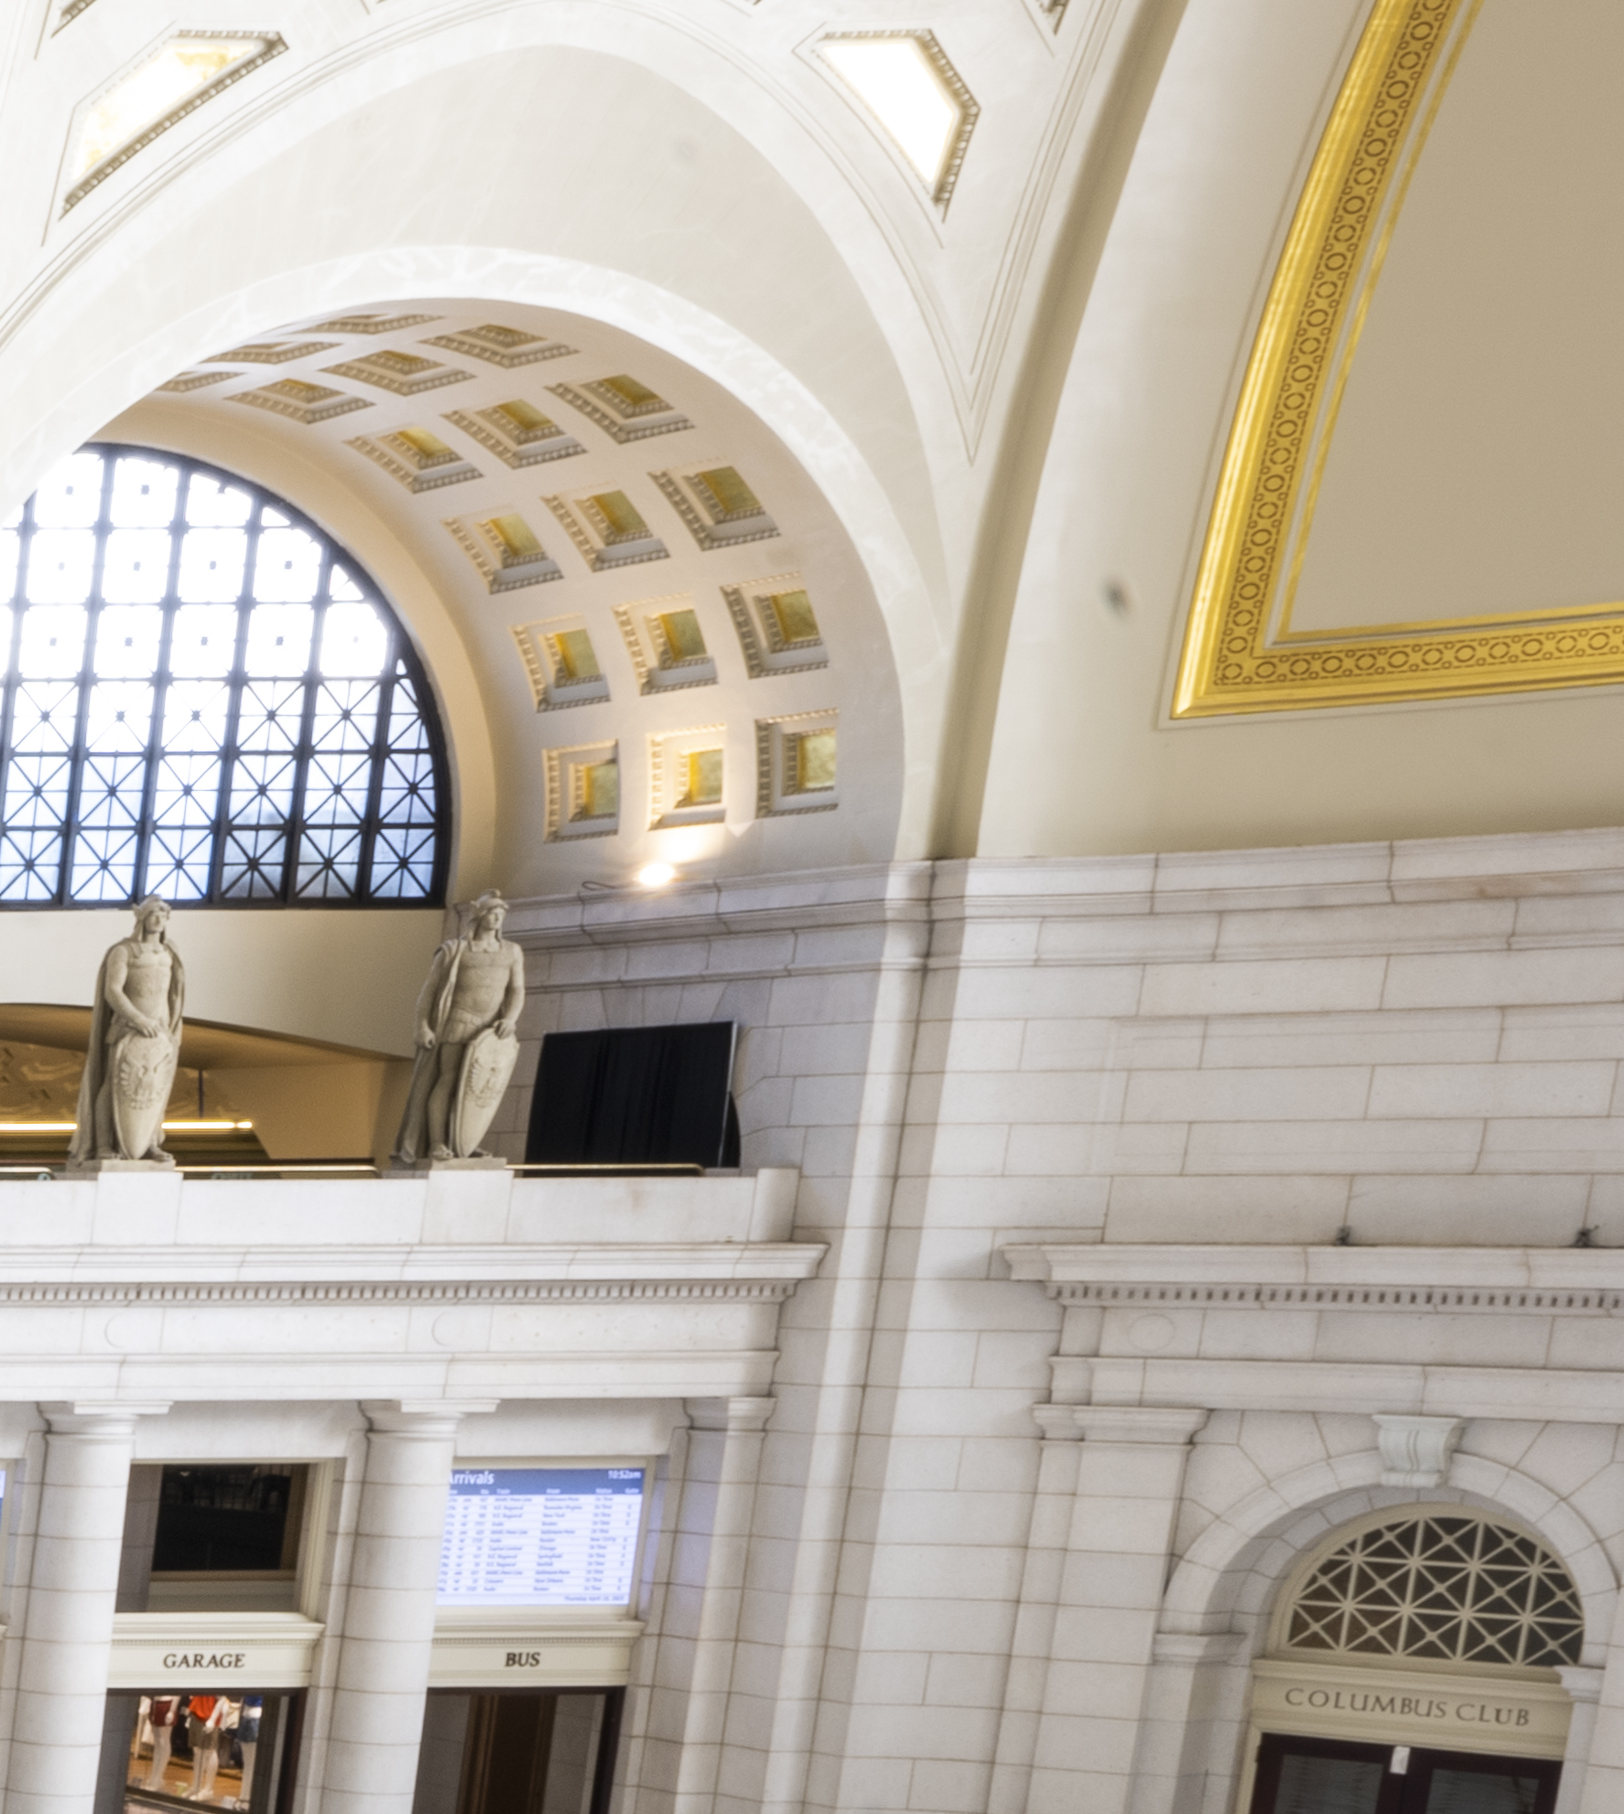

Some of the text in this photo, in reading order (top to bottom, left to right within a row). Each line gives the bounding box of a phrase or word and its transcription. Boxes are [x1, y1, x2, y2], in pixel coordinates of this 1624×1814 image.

[162, 1651, 246, 1670] GARAGE
[503, 1650, 541, 1668] BUS
[1283, 1686, 1531, 1727] COLUMBUS CLUB
